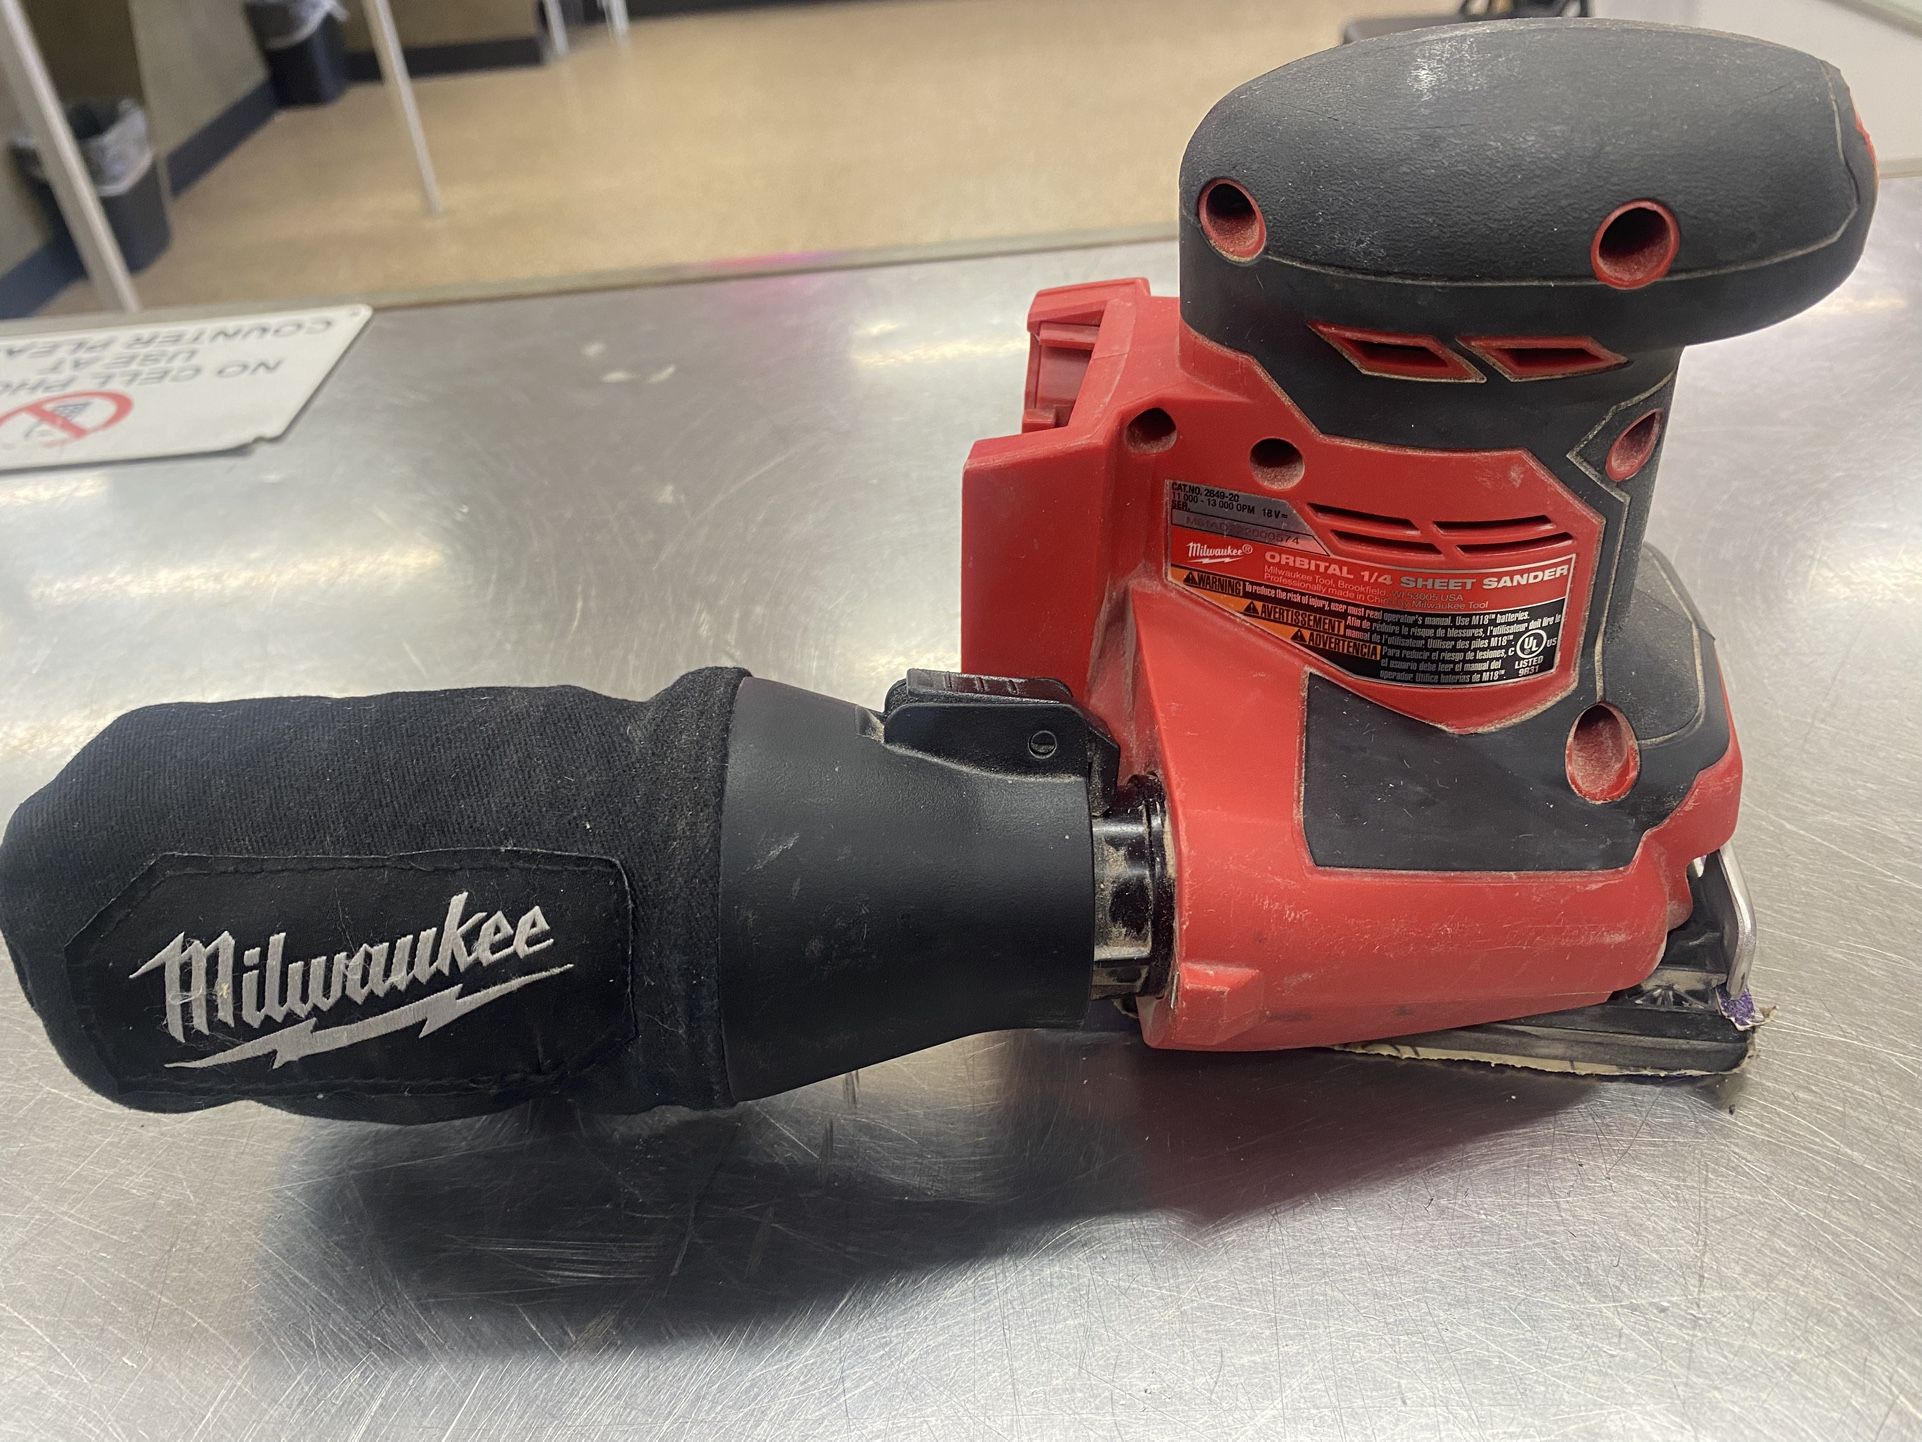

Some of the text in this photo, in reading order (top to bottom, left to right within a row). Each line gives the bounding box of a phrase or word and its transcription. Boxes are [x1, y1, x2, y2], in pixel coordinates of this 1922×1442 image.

[124, 318, 332, 349] COUNTER
[36, 350, 198, 375] USE AT
[91, 367, 201, 387] CELL
[216, 358, 285, 378] NO
[1264, 551, 1569, 590] ORBITAL 1/4 SHEET SANDER
[1264, 565, 1313, 581] Milwaukee
[1440, 593, 1464, 601] USA
[1197, 573, 1241, 596] WARNING
[1245, 582, 1252, 591] To
[1253, 585, 1276, 597] reduce
[1276, 589, 1287, 600] the
[1287, 592, 1301, 603] risk
[1302, 596, 1308, 605] of
[1309, 596, 1329, 610] injury,
[1330, 602, 1346, 612] user
[1347, 605, 1364, 617] must
[1365, 609, 1382, 620] read
[1456, 615, 1470, 625] Use
[1496, 611, 1530, 624] batteries.
[1264, 573, 1326, 595] Professionally
[1328, 587, 1355, 598] made
[1357, 590, 1365, 600] in
[1412, 600, 1466, 610] Milwaukee
[1469, 601, 1489, 609] Tool
[1260, 602, 1342, 635] AVERTISSEMENT
[1346, 616, 1361, 627] Afin
[1362, 619, 1371, 629] de
[1401, 625, 1408, 635] le
[1410, 626, 1435, 638] risque
[1436, 627, 1446, 637] de
[1308, 631, 1378, 660] ADVERTENCIA
[1383, 646, 1400, 658] Para
[1465, 651, 1475, 660] de
[1371, 632, 1381, 642] de
[1456, 639, 1470, 649] des
[1471, 637, 1489, 649] piles
[1490, 659, 1502, 669] del
[1514, 655, 1544, 669] LISTED
[1471, 673, 1480, 682] de
[128, 891, 555, 1043] Milwaukee
